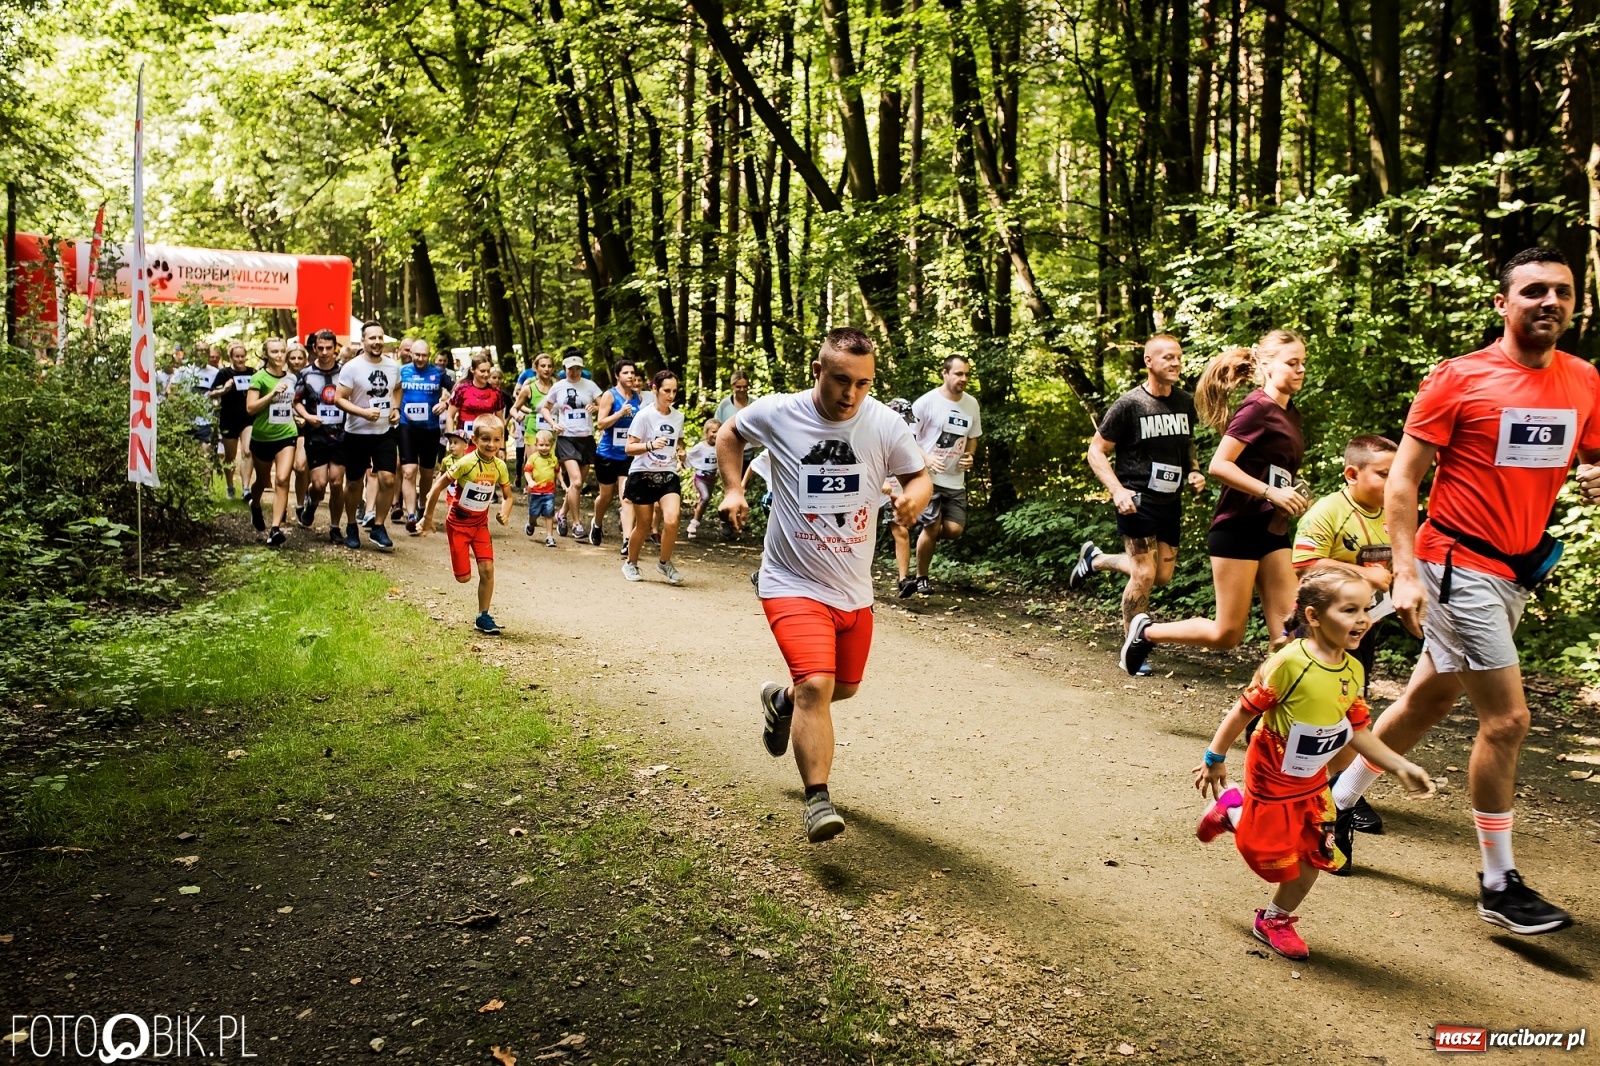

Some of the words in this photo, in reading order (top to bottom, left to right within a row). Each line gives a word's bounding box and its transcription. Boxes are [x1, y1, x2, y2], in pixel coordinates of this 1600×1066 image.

[401, 381, 440, 391] UNNERS
[1526, 426, 1552, 443] 76
[1163, 471, 1175, 481] 69
[822, 477, 846, 492] 23
[474, 493, 488, 502] 40
[794, 531, 820, 541] LIDIA
[1317, 734, 1339, 754] 77
